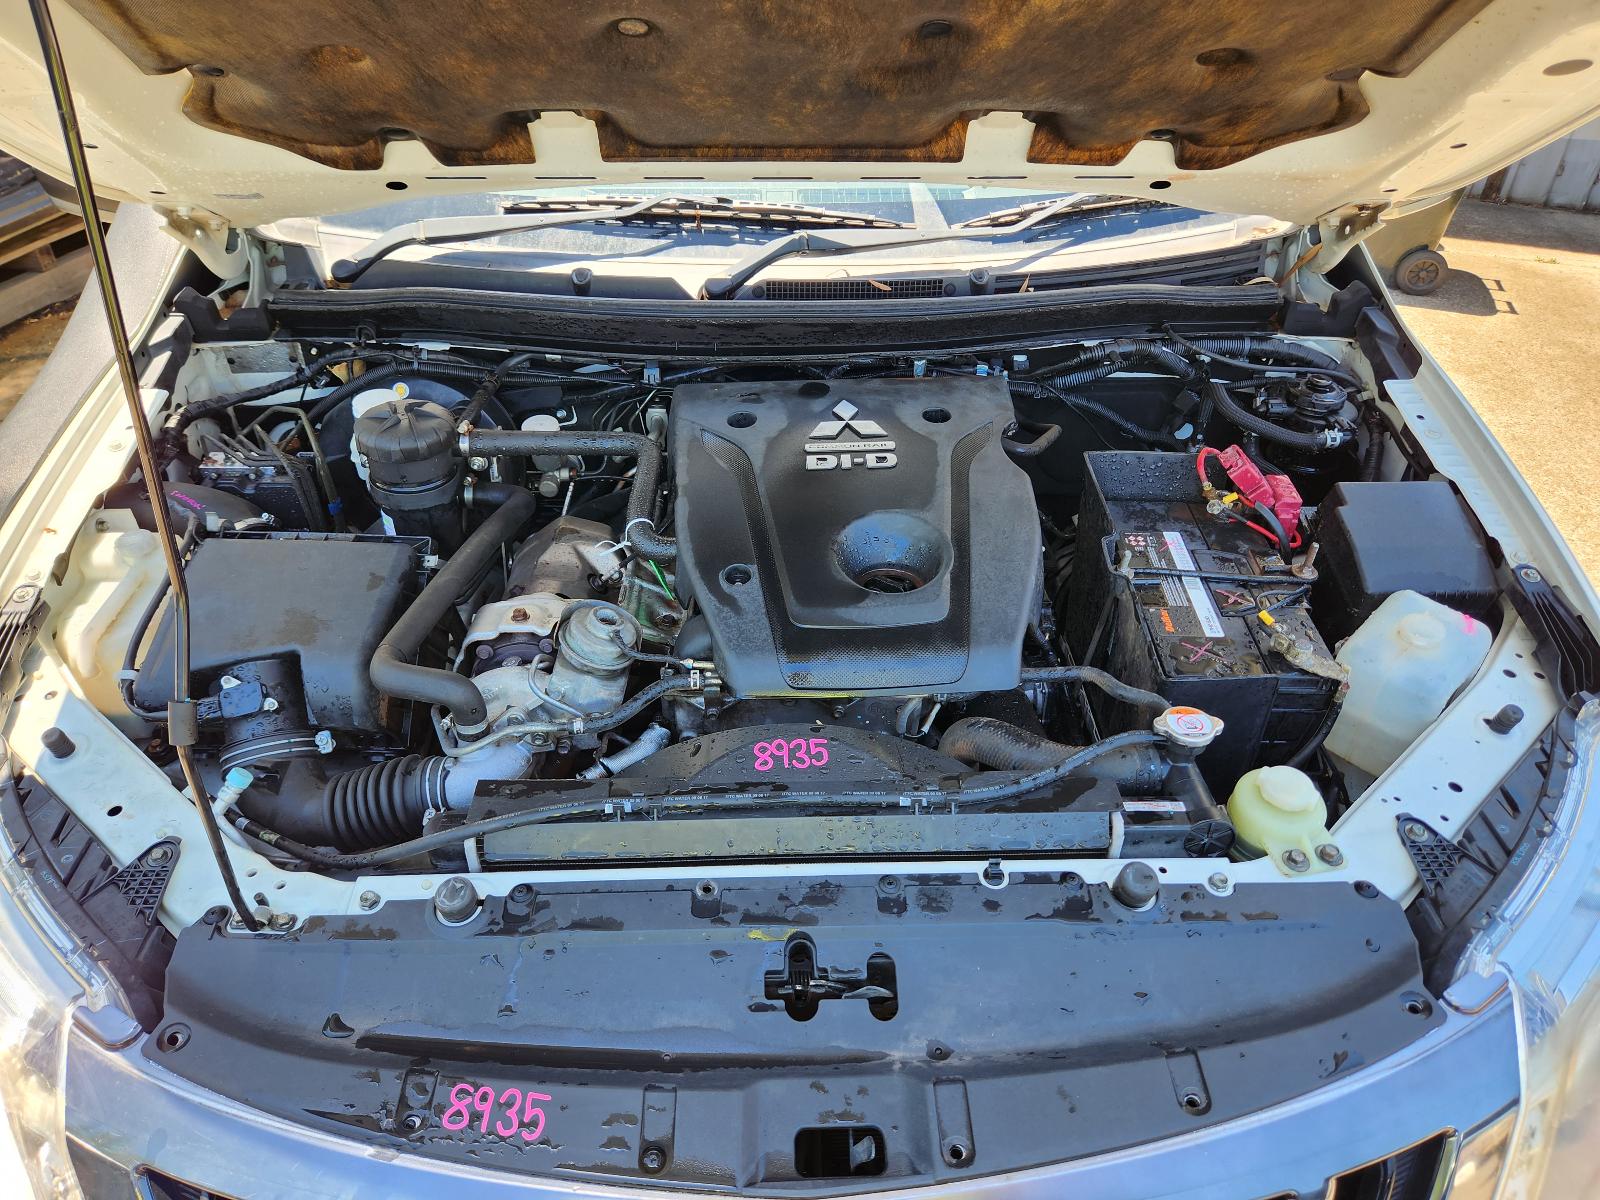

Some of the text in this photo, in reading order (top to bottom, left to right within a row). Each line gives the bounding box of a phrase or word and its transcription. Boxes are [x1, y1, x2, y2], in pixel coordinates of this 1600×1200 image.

[806, 453, 898, 470] DI-D
[753, 738, 829, 771] 8935
[442, 1083, 552, 1140] 8935
